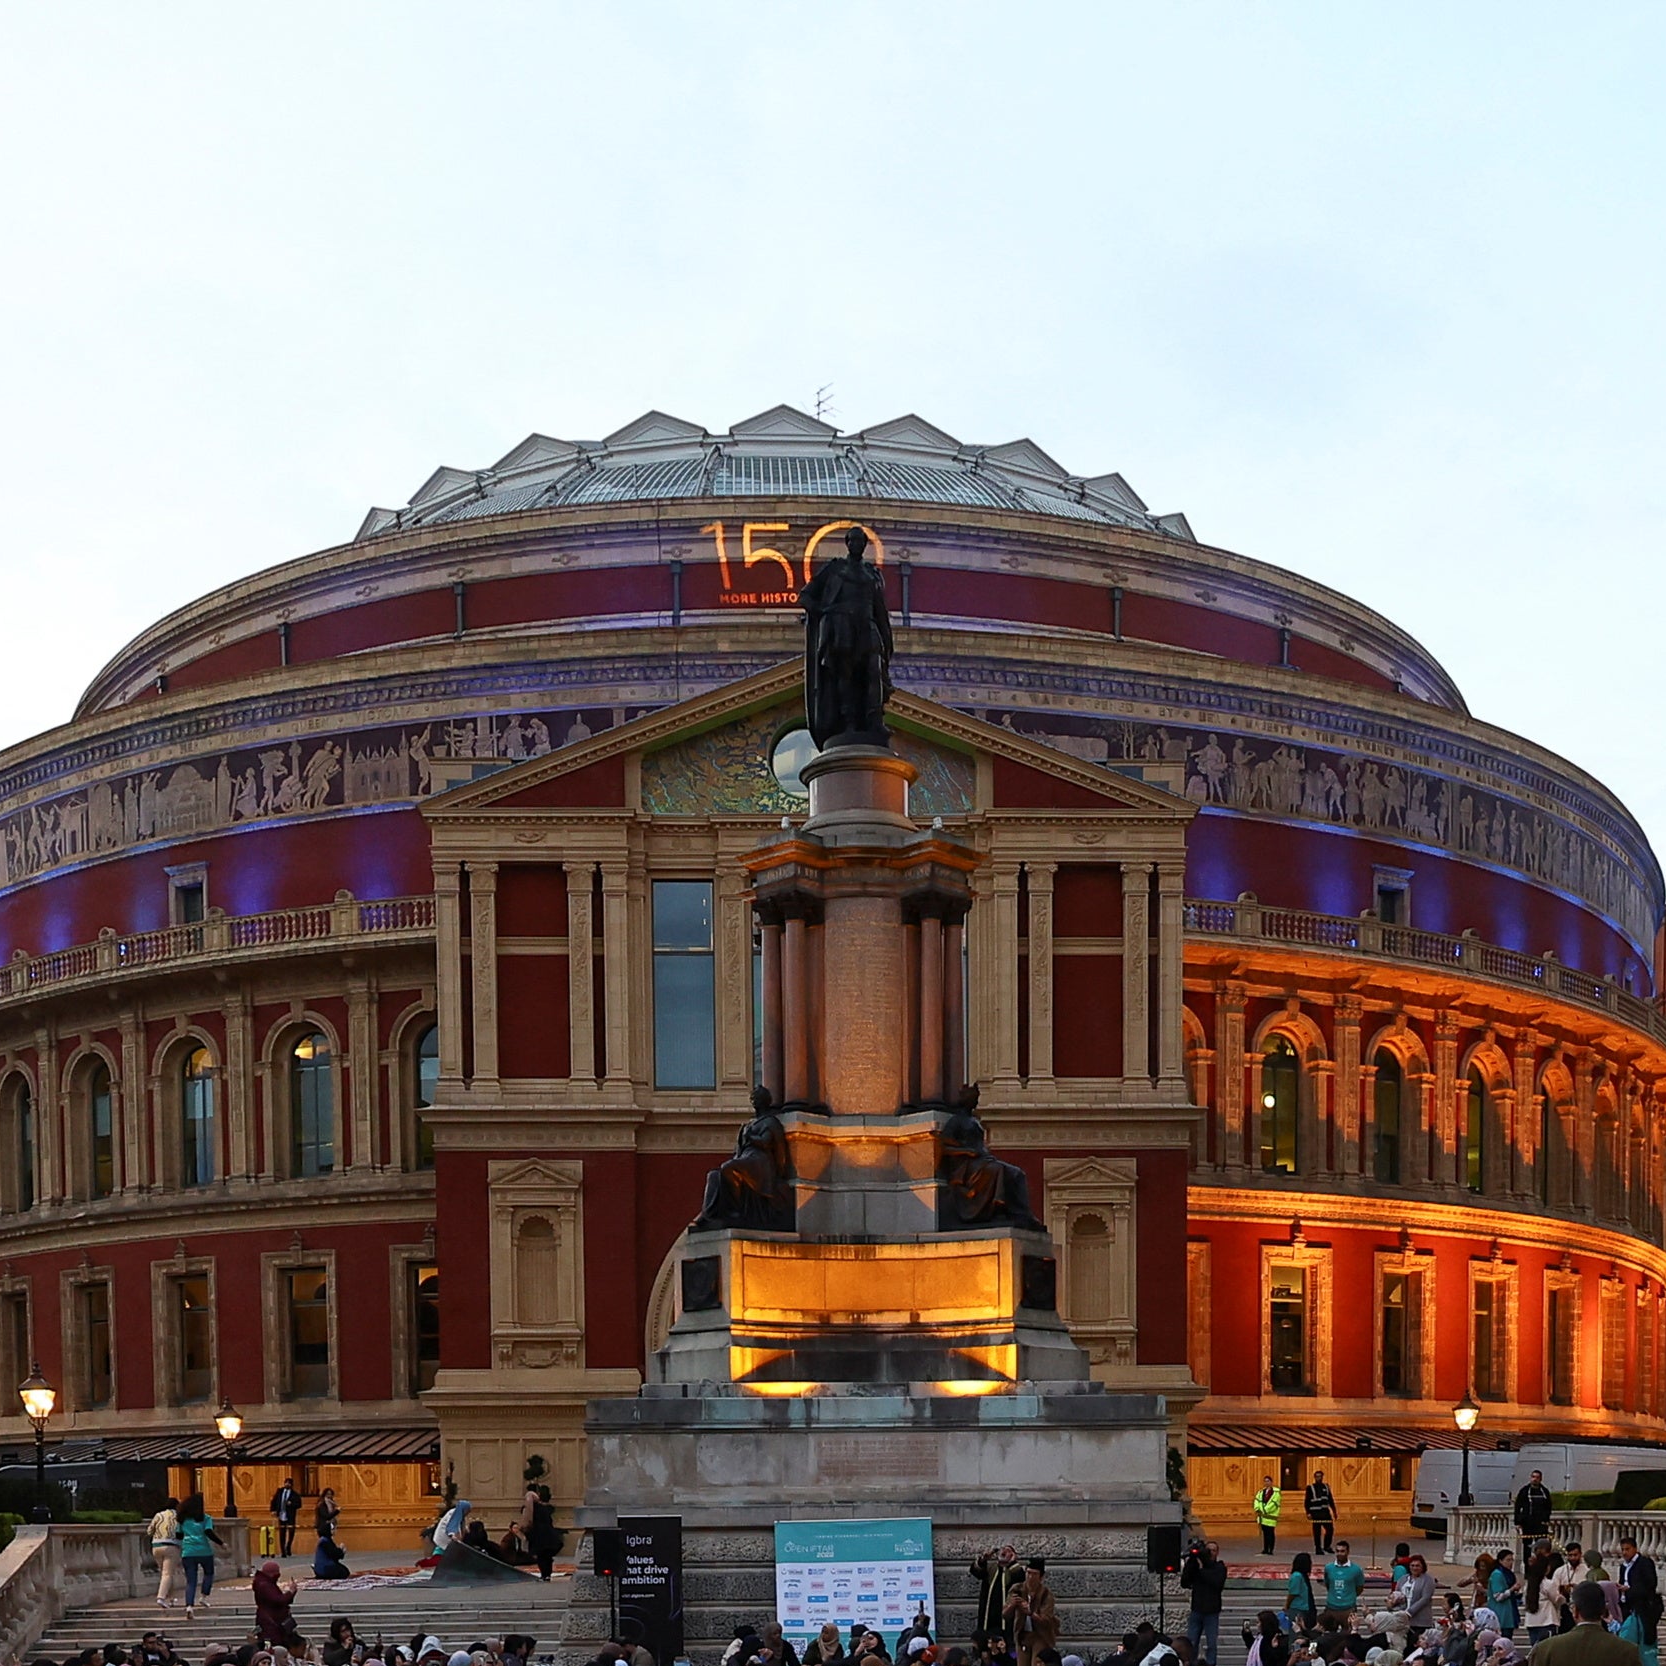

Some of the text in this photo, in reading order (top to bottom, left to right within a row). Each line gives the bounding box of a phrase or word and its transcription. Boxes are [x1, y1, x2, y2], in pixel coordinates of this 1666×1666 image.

[699, 520, 884, 590] 150
[720, 593, 757, 604] MORE
[1158, 706, 1174, 718] BY
[291, 717, 330, 734] QUEEN
[626, 1535, 653, 1547] lgbra
[643, 1565, 669, 1574] drive
[621, 1575, 666, 1585] ambition
